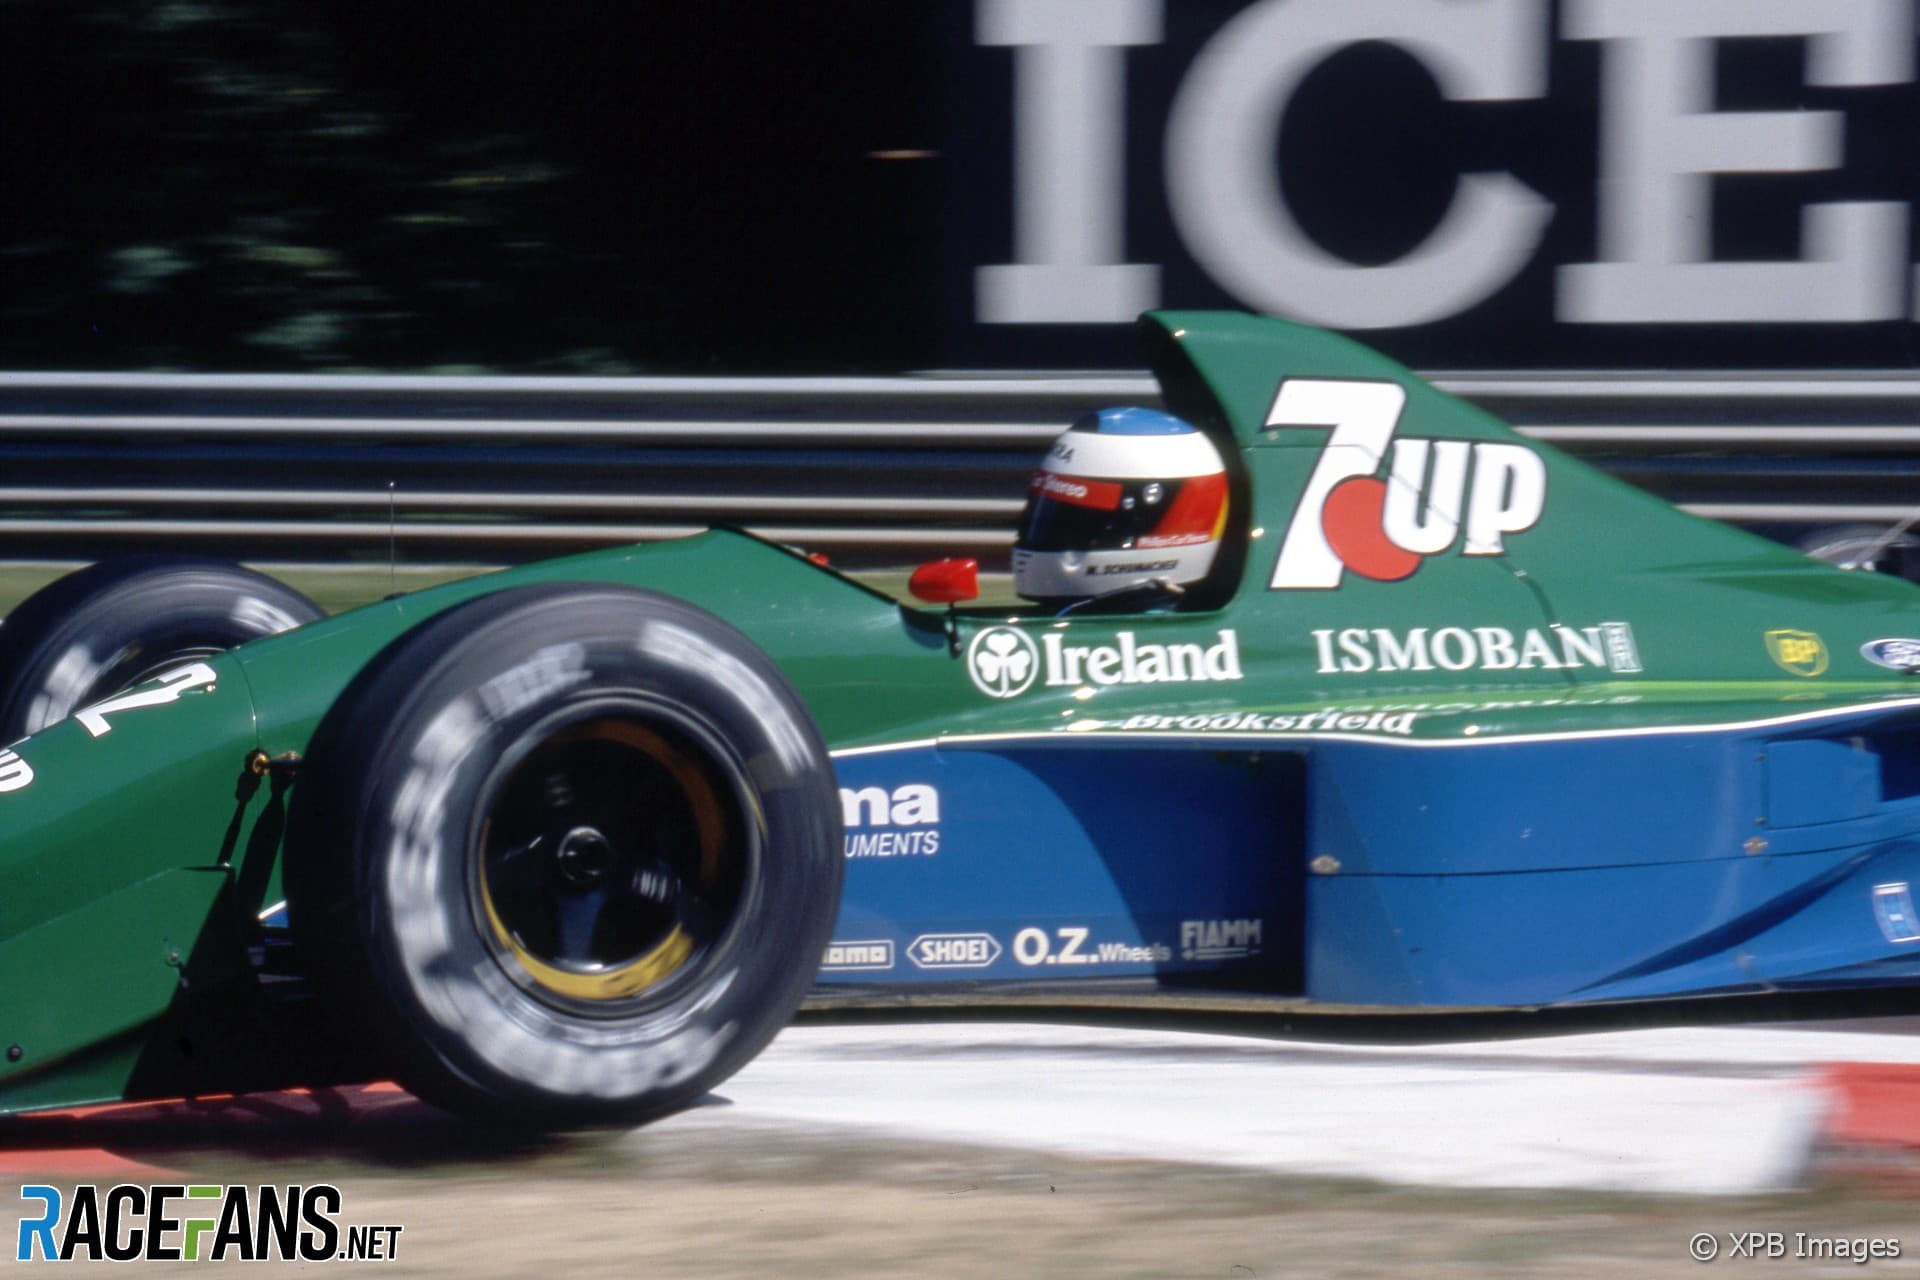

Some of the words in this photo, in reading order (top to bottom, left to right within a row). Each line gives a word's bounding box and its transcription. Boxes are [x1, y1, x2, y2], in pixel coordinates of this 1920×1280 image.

[963, 0, 1920, 329] ICE
[1043, 629, 1243, 686] Ireland
[1312, 627, 1606, 673] ISMOBAN
[1121, 707, 1418, 735] Brooksfield
[838, 783, 941, 827] ma
[844, 830, 940, 858] UMENTS
[920, 939, 989, 963] SHOEI
[1013, 927, 1099, 966] O.Z.
[1181, 919, 1263, 948] FIAMM
